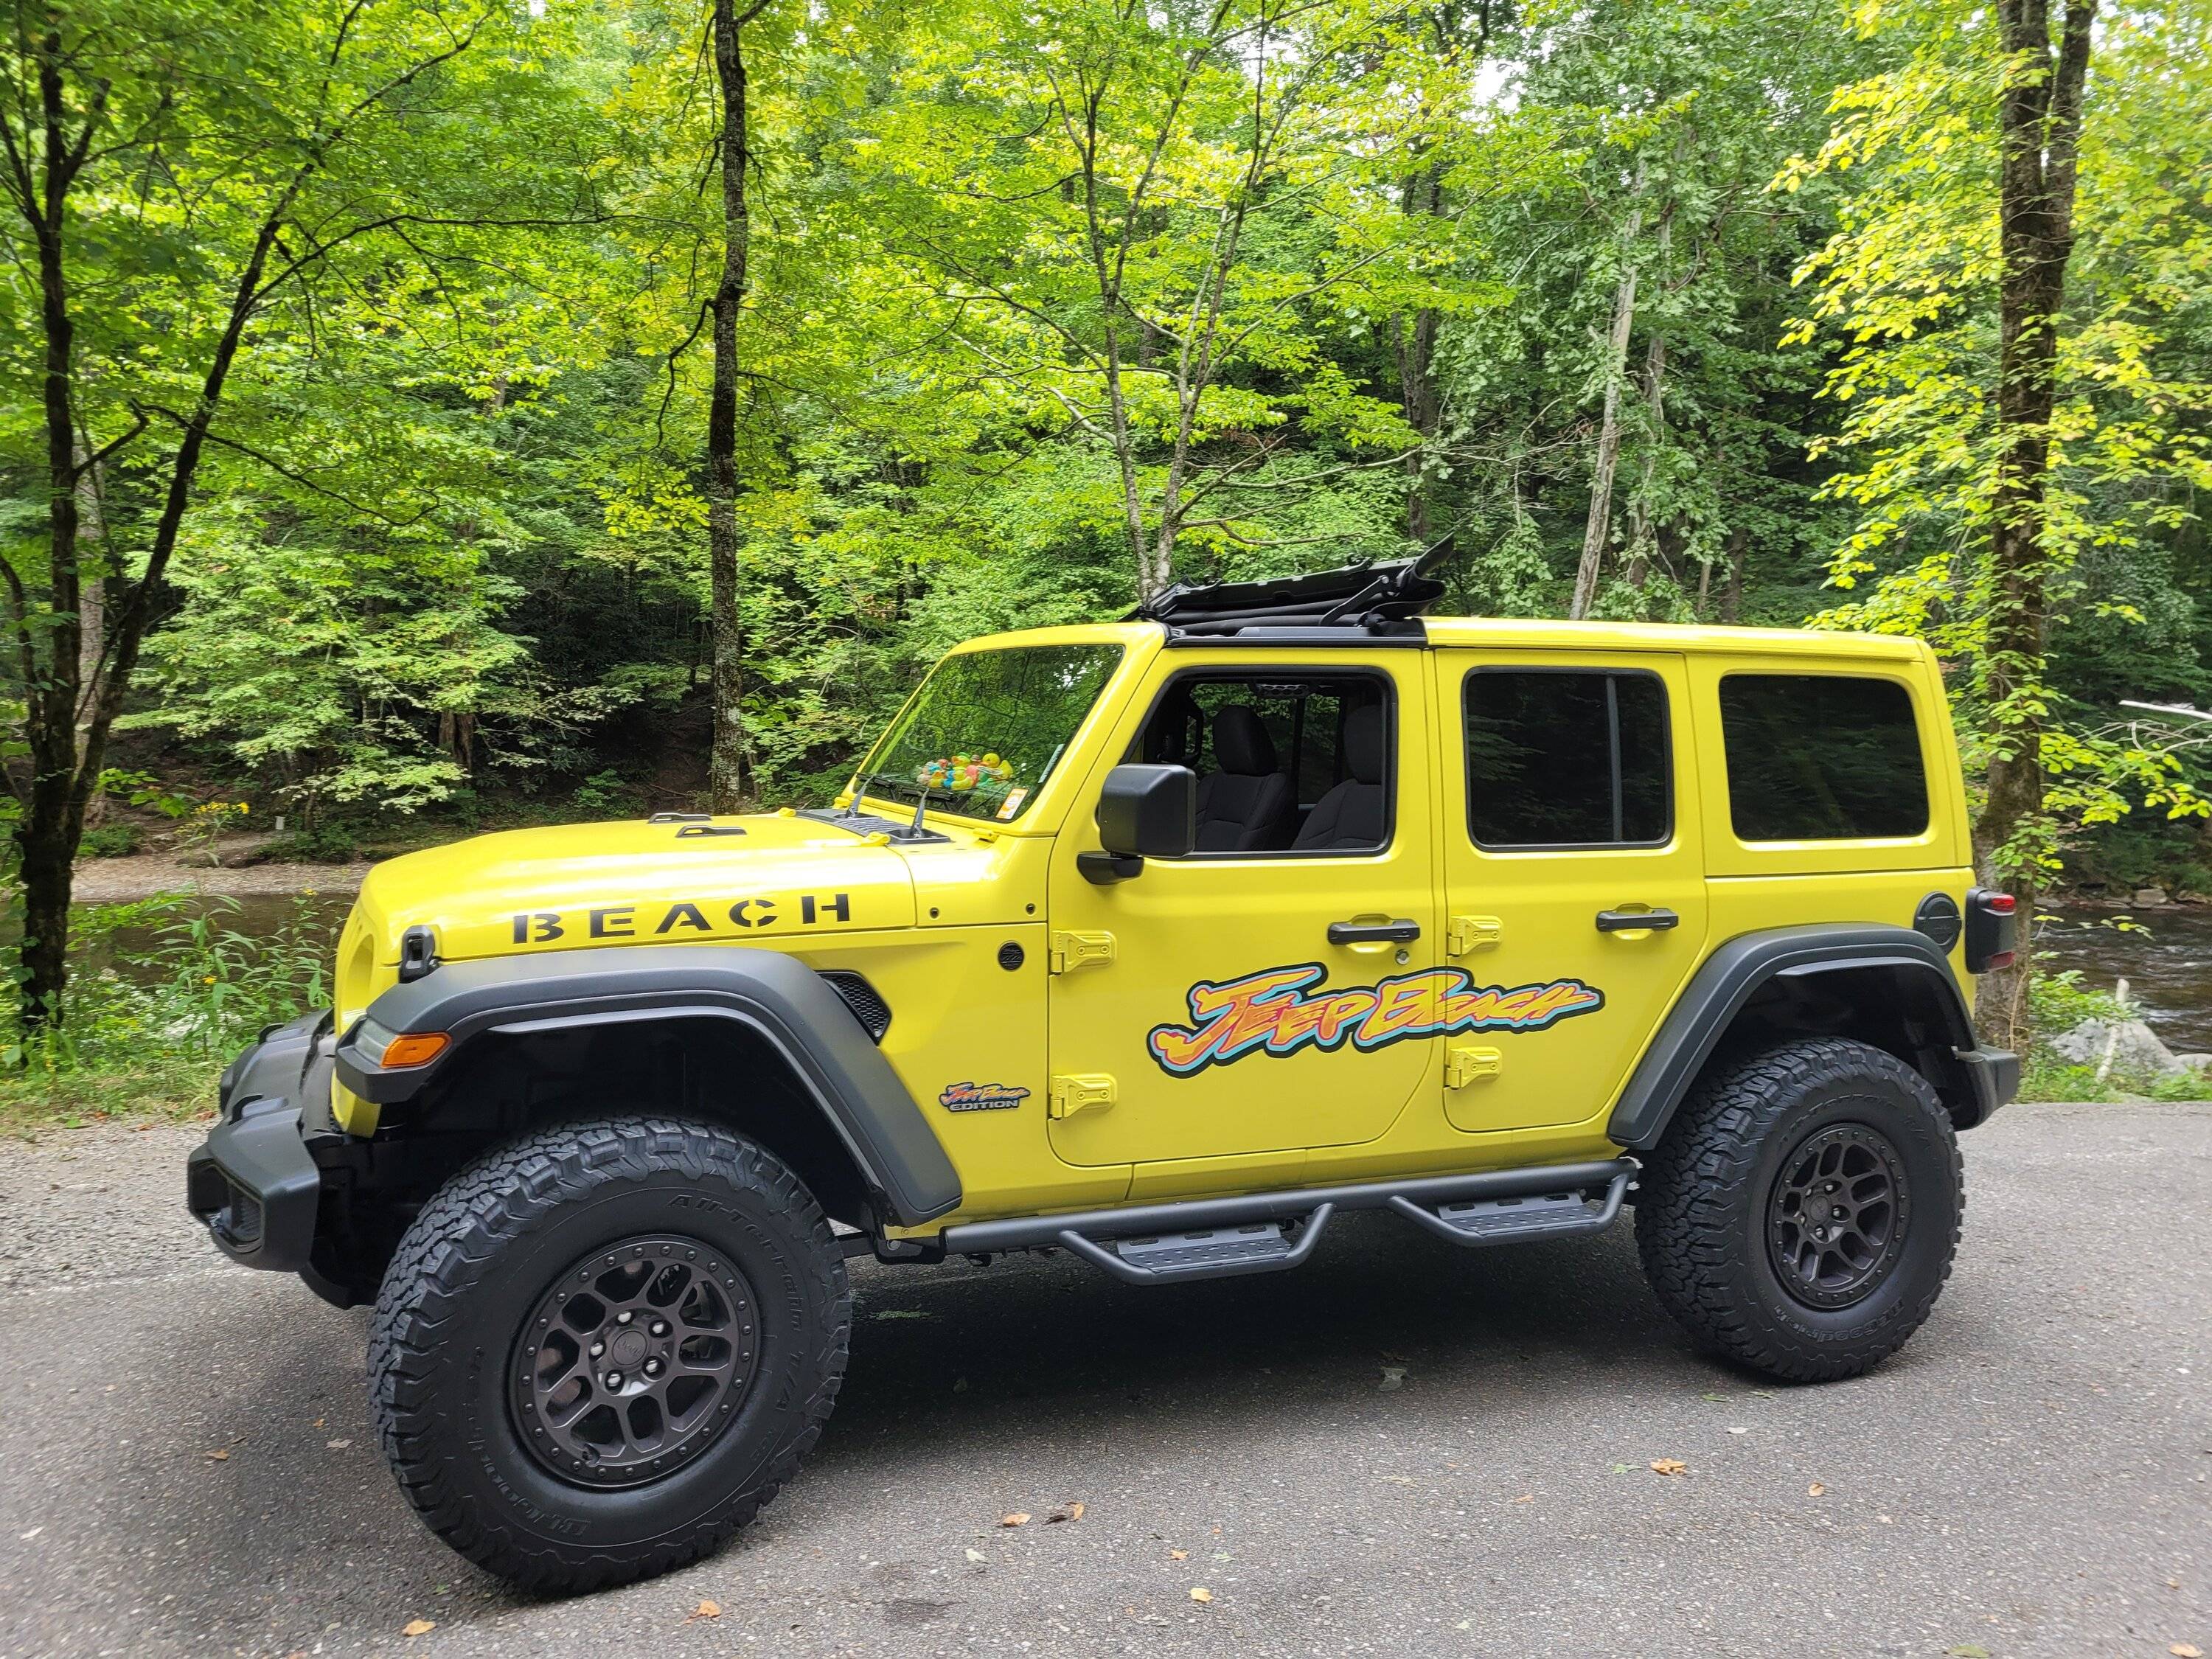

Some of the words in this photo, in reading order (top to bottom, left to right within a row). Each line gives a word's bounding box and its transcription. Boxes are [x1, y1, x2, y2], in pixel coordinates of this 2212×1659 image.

[512, 893, 851, 945] BEACH
[1149, 963, 1377, 1075] JEEP
[1355, 969, 1600, 1046] BEACH
[949, 1100, 1018, 1111] EDITION
